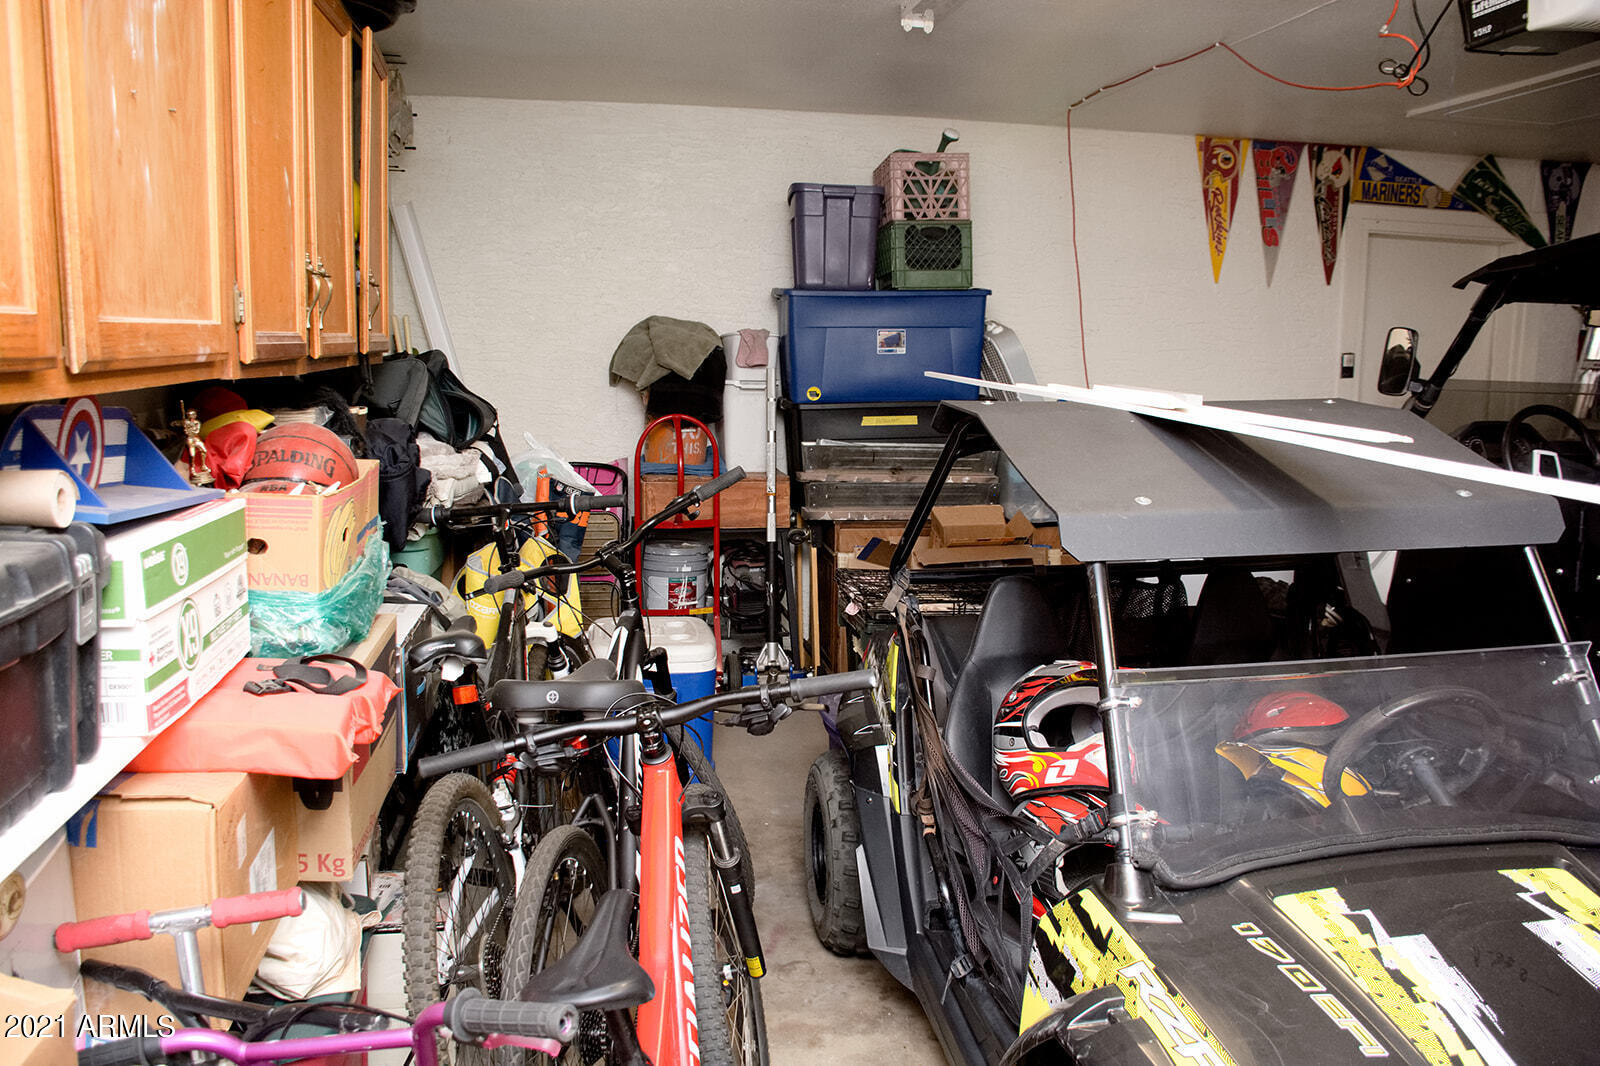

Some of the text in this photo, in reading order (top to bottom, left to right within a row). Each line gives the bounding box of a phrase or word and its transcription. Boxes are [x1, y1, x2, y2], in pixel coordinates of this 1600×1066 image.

[1253, 149, 1280, 248] BILLS
[1361, 181, 1422, 206] MARINERS
[251, 448, 337, 479] PALDING
[247, 572, 309, 588] BANAN
[317, 853, 347, 878] Kg
[1309, 993, 1390, 1058] EFI
